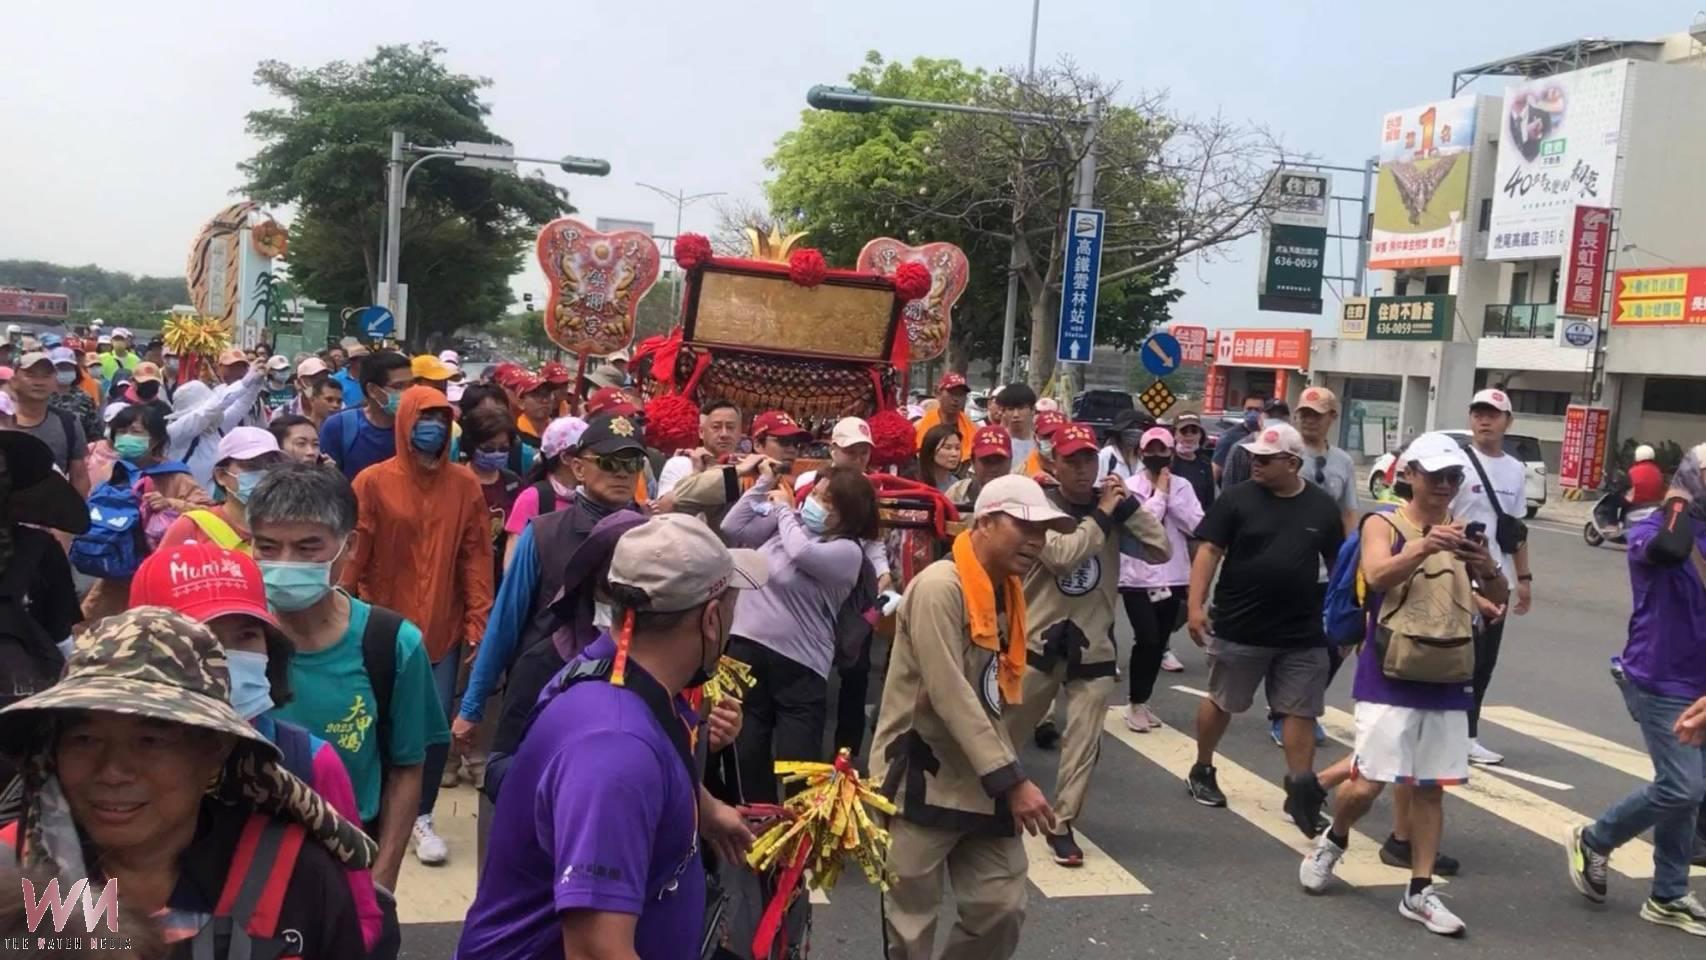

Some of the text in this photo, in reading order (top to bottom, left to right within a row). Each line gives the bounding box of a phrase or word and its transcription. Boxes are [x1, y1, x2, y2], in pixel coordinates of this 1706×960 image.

[1286, 176, 1320, 196] 住商
[1274, 255, 1319, 269] 636-0059
[1572, 231, 1599, 303] 長虹房屋
[1071, 239, 1092, 325] 高鐵雲林站
[1346, 305, 1364, 319] 住商
[1378, 302, 1434, 321] 住商不動產
[1376, 322, 1412, 334] 636-0059
